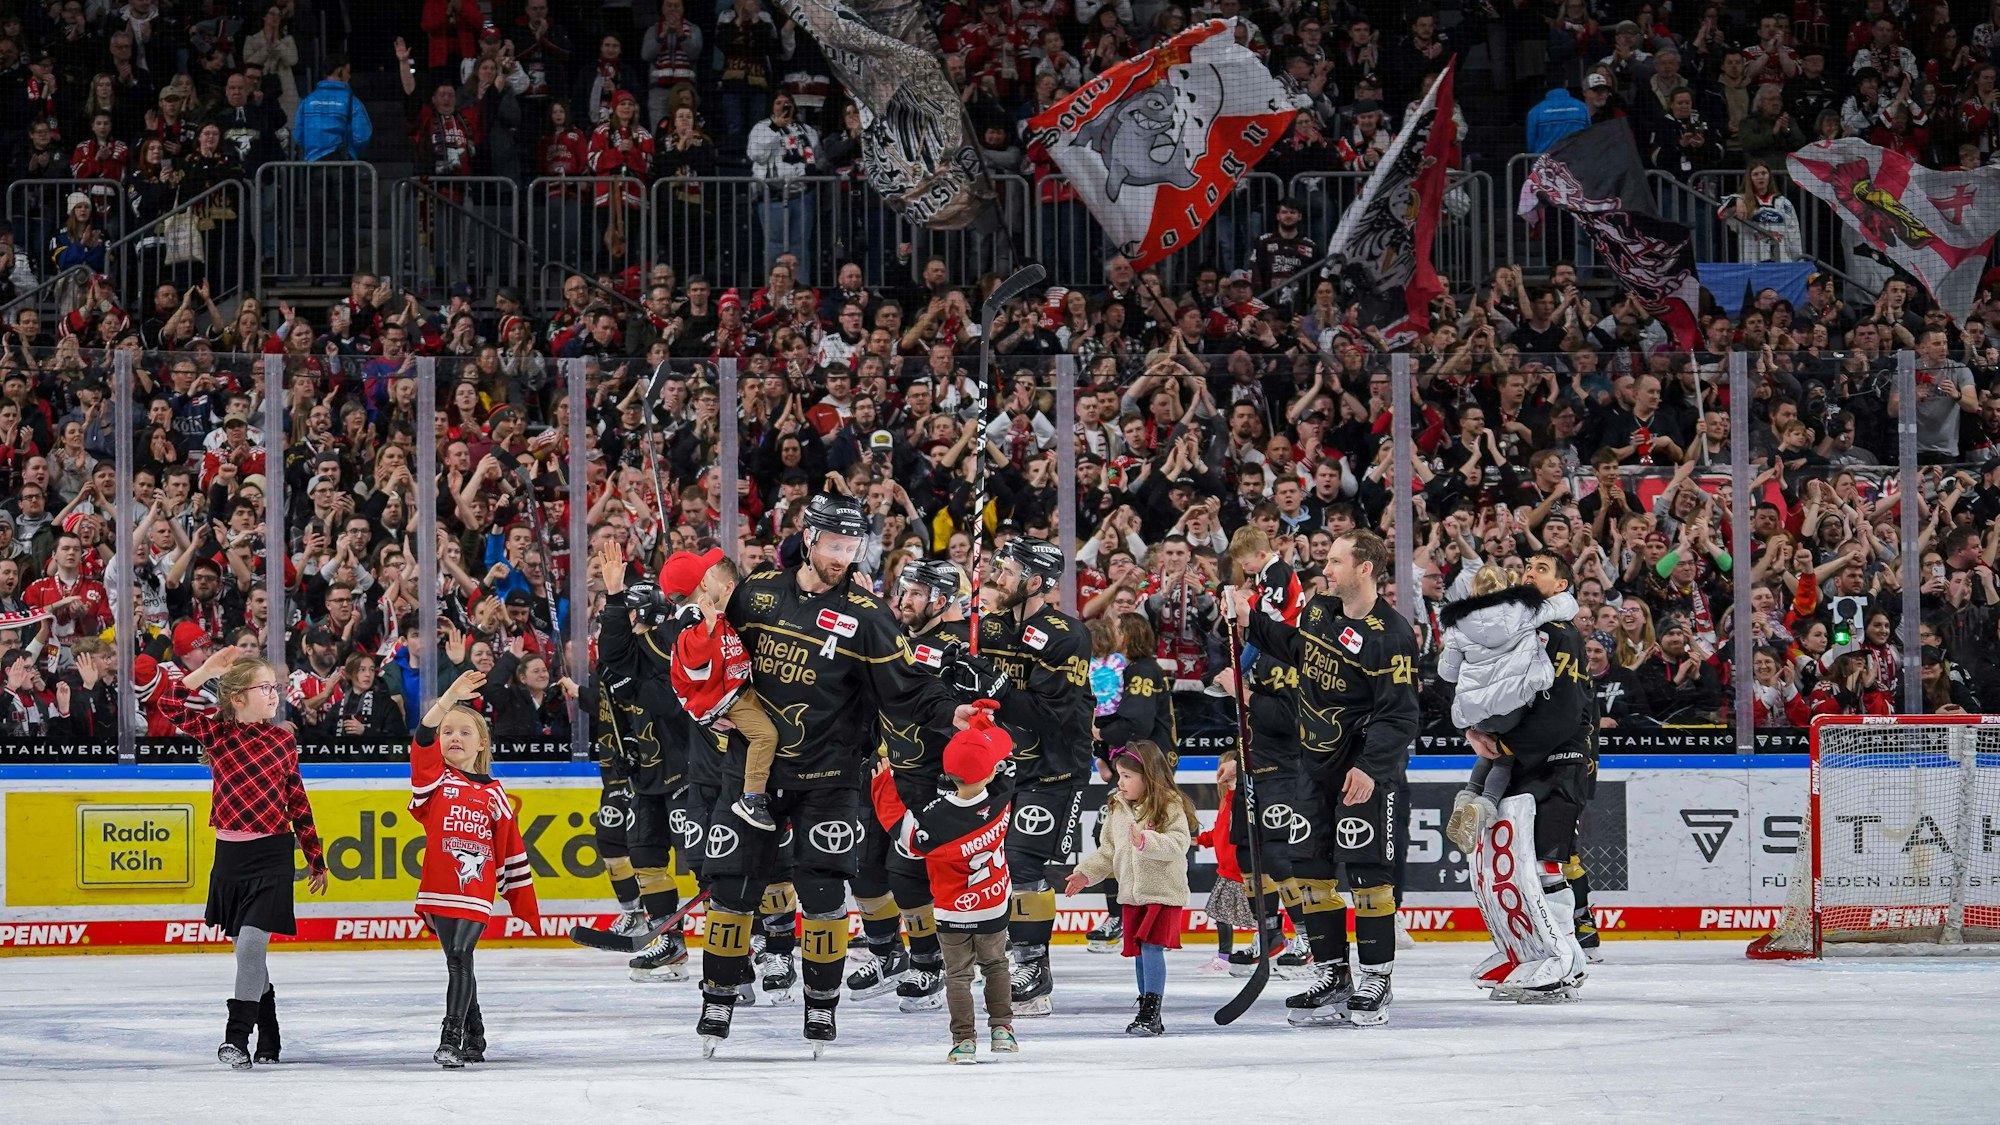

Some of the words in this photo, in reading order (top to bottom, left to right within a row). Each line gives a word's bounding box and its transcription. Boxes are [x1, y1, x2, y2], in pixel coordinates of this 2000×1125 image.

[1032, 545, 1062, 555] STETSON
[936, 566, 958, 574] STETSO
[1263, 587, 1284, 603] 24
[757, 632, 809, 665] Rhein
[819, 635, 838, 660] A
[1304, 641, 1339, 675] Rhein
[1067, 655, 1088, 687] 39
[1271, 666, 1298, 690] 24
[1391, 655, 1412, 684] 21
[1554, 652, 1579, 684] 74
[1130, 676, 1154, 697] 36
[140, 745, 203, 755] STAHL
[1547, 751, 1583, 763] BAUER
[805, 770, 841, 780] BAUER
[1245, 774, 1255, 825] SYNC
[450, 805, 489, 827] Rhein
[1067, 791, 1083, 834] TOYOTA
[1386, 791, 1395, 838] TOYOTA
[103, 821, 170, 842] Radio
[110, 850, 163, 871] Köln
[708, 922, 743, 949] ETL
[804, 929, 839, 955] ETL
